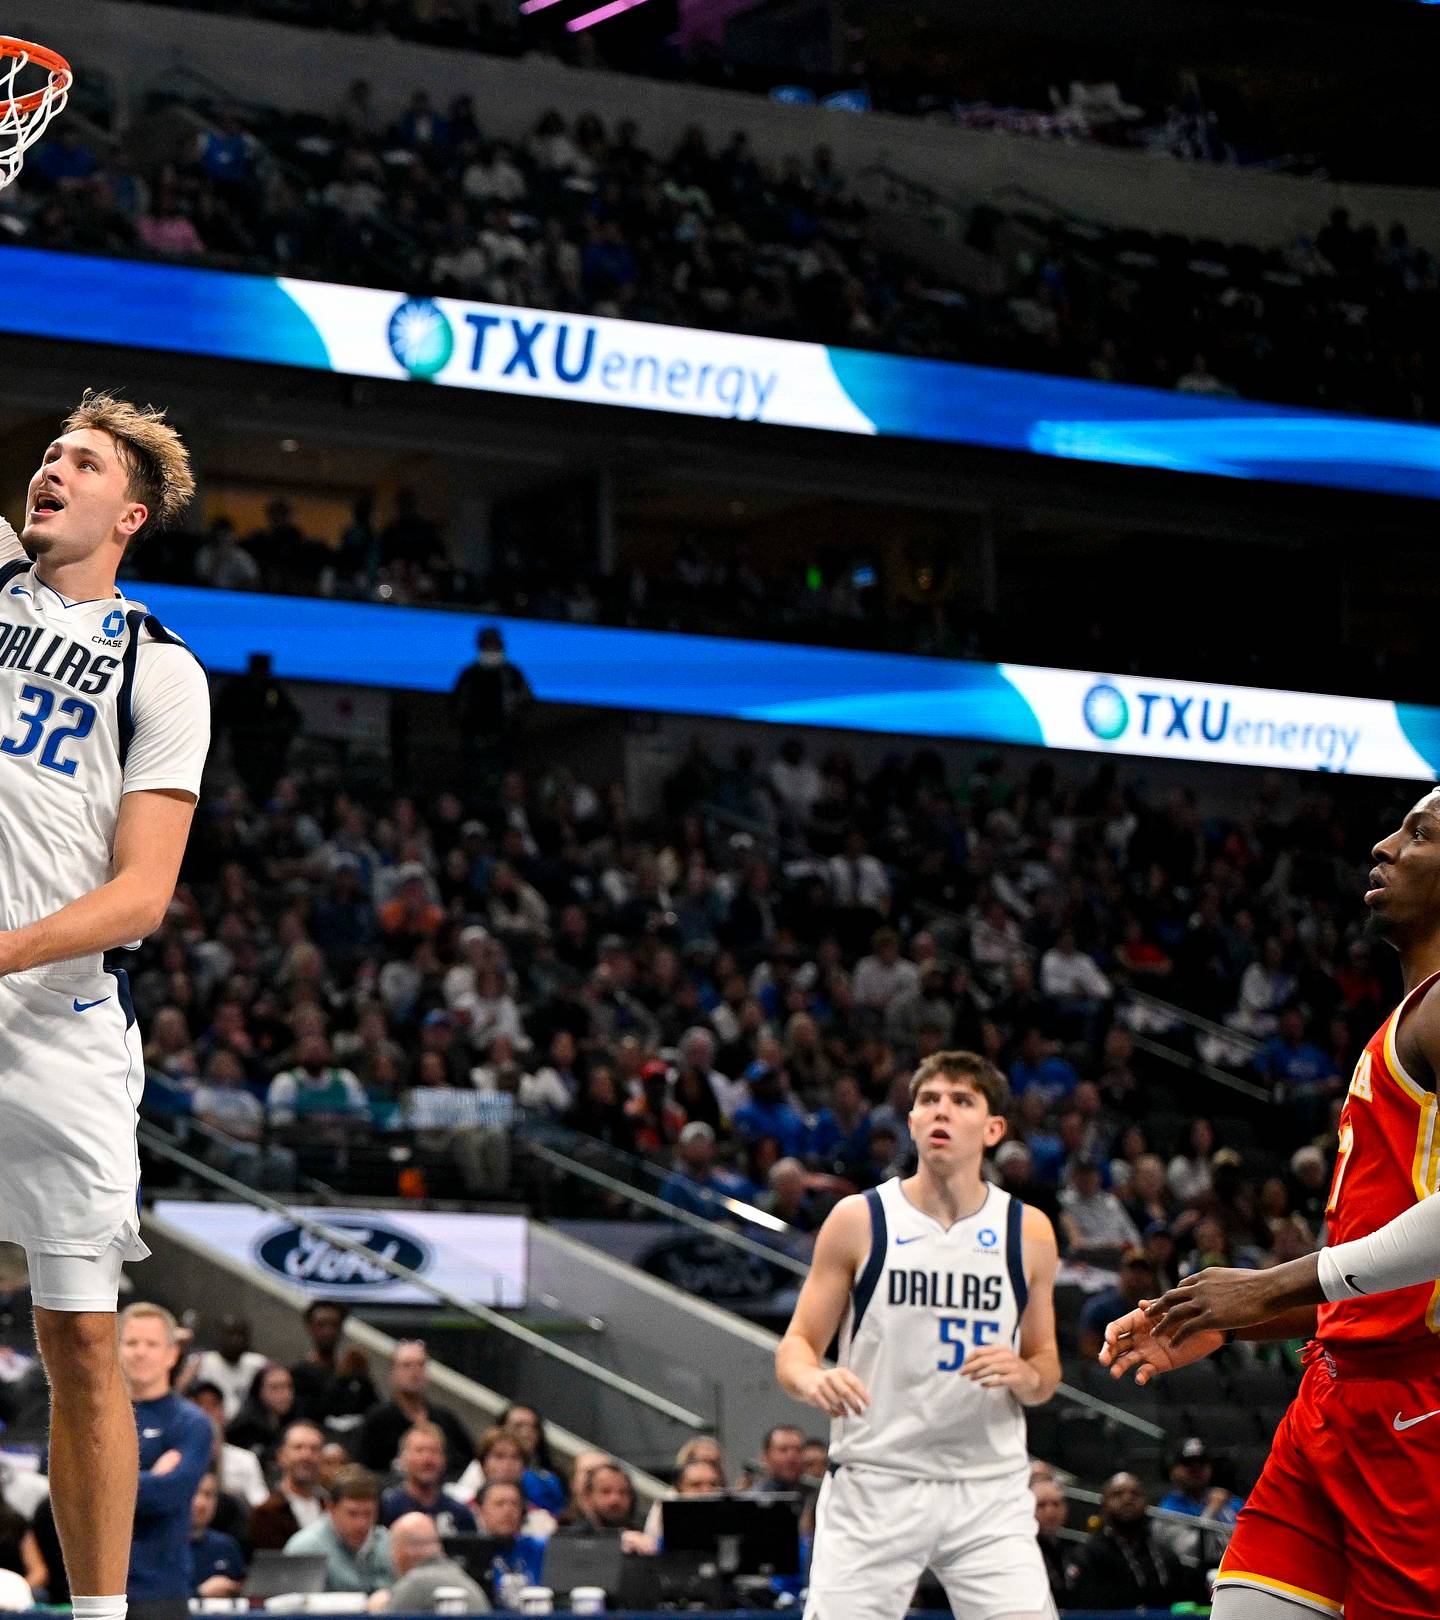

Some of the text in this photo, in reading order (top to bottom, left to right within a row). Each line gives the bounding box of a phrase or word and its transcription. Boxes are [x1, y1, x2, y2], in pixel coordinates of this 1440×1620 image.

[464, 313, 779, 421] TXU energy
[91, 635, 123, 648] CHASE
[1136, 692, 1363, 774] TXU energy
[283, 1226, 401, 1282] Ford
[887, 1268, 1003, 1312] DALLAS
